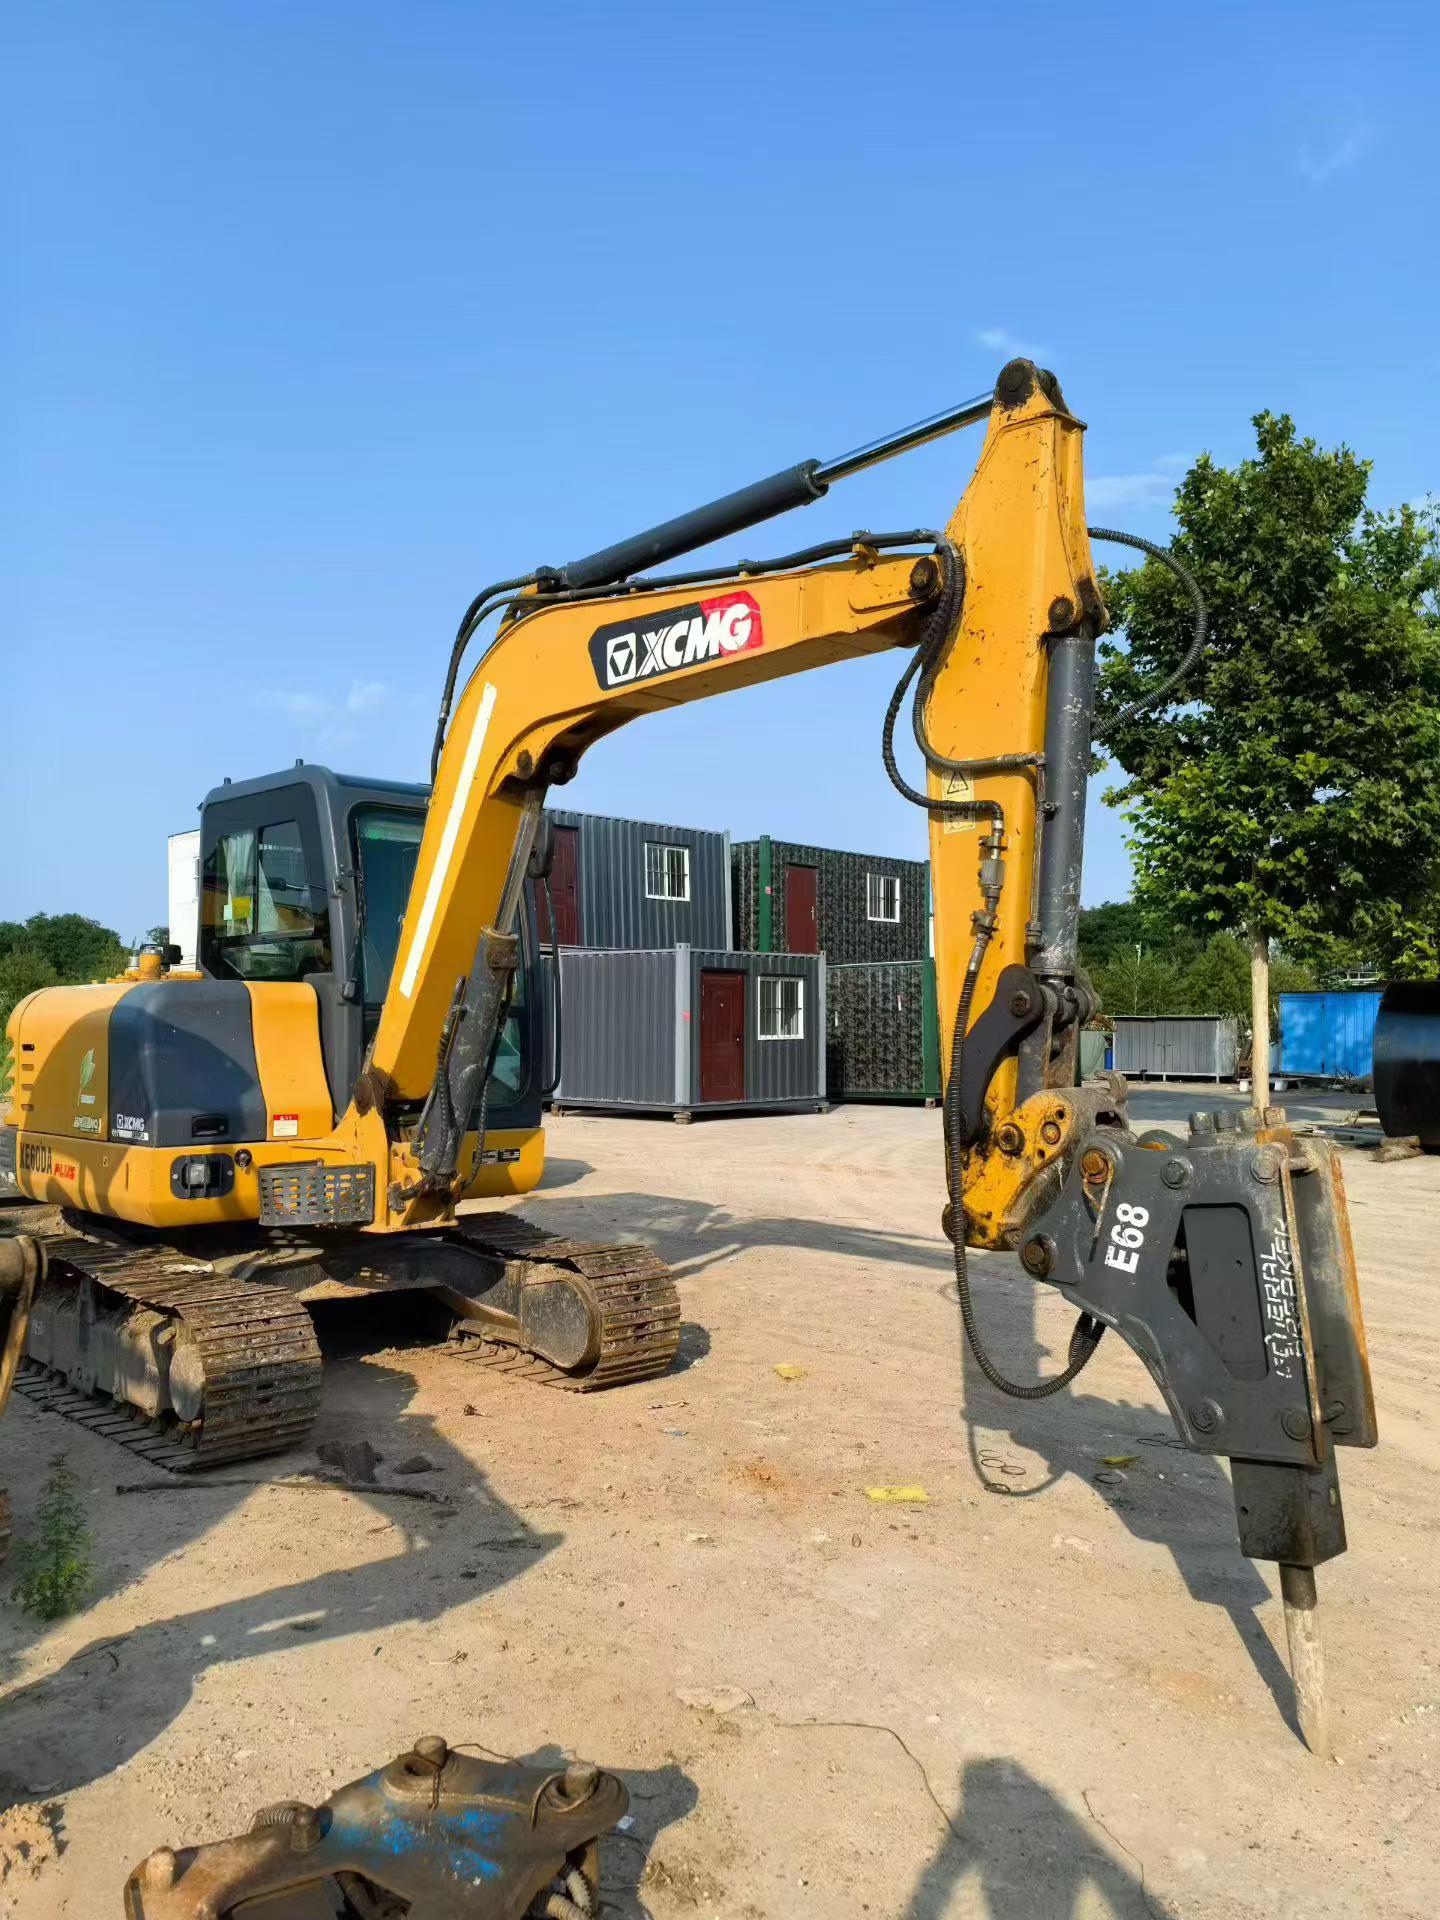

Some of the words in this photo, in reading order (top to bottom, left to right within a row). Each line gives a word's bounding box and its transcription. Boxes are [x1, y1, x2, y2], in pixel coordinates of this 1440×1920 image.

[636, 604, 752, 677] XCMG
[123, 1116, 145, 1131] XCMG
[20, 1142, 52, 1175] XE60DA
[1105, 1203, 1149, 1273] E68
